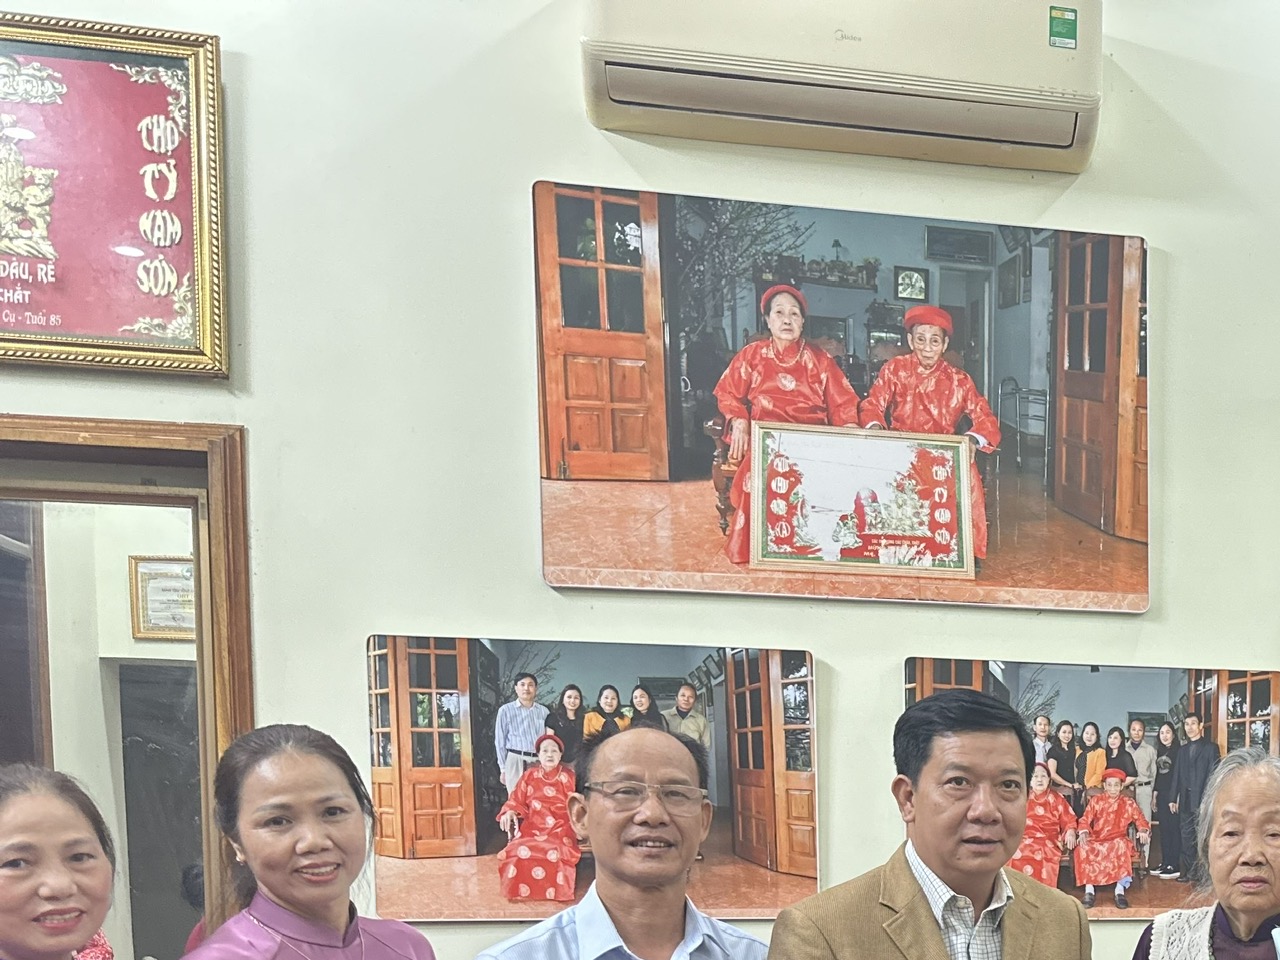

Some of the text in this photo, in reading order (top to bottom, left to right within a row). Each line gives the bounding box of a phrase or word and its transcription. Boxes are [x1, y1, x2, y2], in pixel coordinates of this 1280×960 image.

[138, 209, 183, 248] NAM
[2, 309, 16, 327] Cụ
[25, 309, 47, 326] Tuổi
[49, 314, 62, 326] 85
